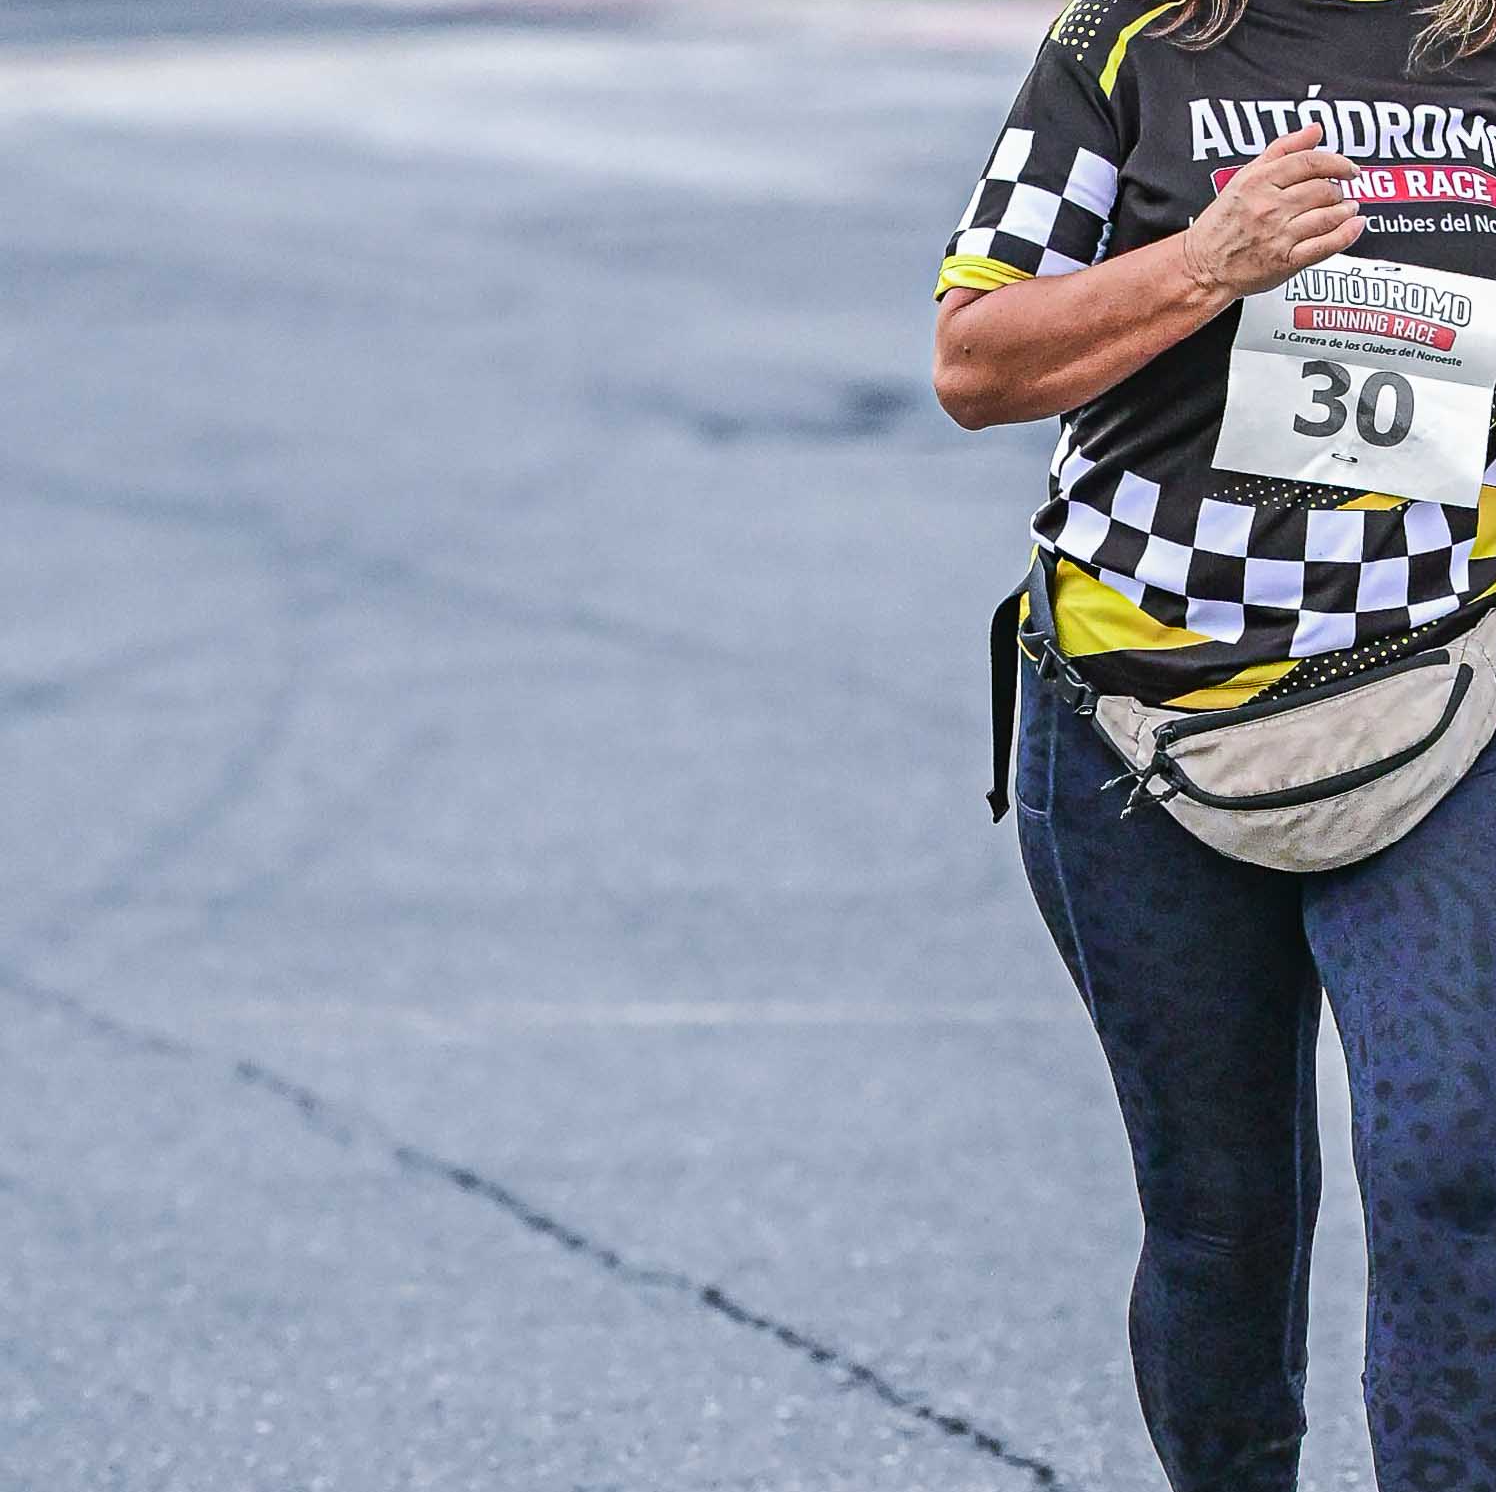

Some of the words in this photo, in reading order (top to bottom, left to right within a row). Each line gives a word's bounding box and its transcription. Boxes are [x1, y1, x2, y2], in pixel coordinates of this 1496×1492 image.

[1404, 170, 1492, 201] RACE
[1366, 214, 1436, 233] Clubes
[1441, 213, 1471, 232] del
[1285, 268, 1471, 327] AUTÓDROMO
[1312, 310, 1388, 333] RUNNING
[1392, 316, 1438, 345] RACE
[1273, 330, 1286, 341] La
[1288, 332, 1326, 347] Carrera
[1329, 337, 1343, 349] de
[1345, 339, 1360, 351] los
[1362, 342, 1396, 356] Clubes
[1399, 347, 1414, 358] del
[1417, 350, 1462, 367] Noroeste
[1293, 360, 1414, 447] 30
